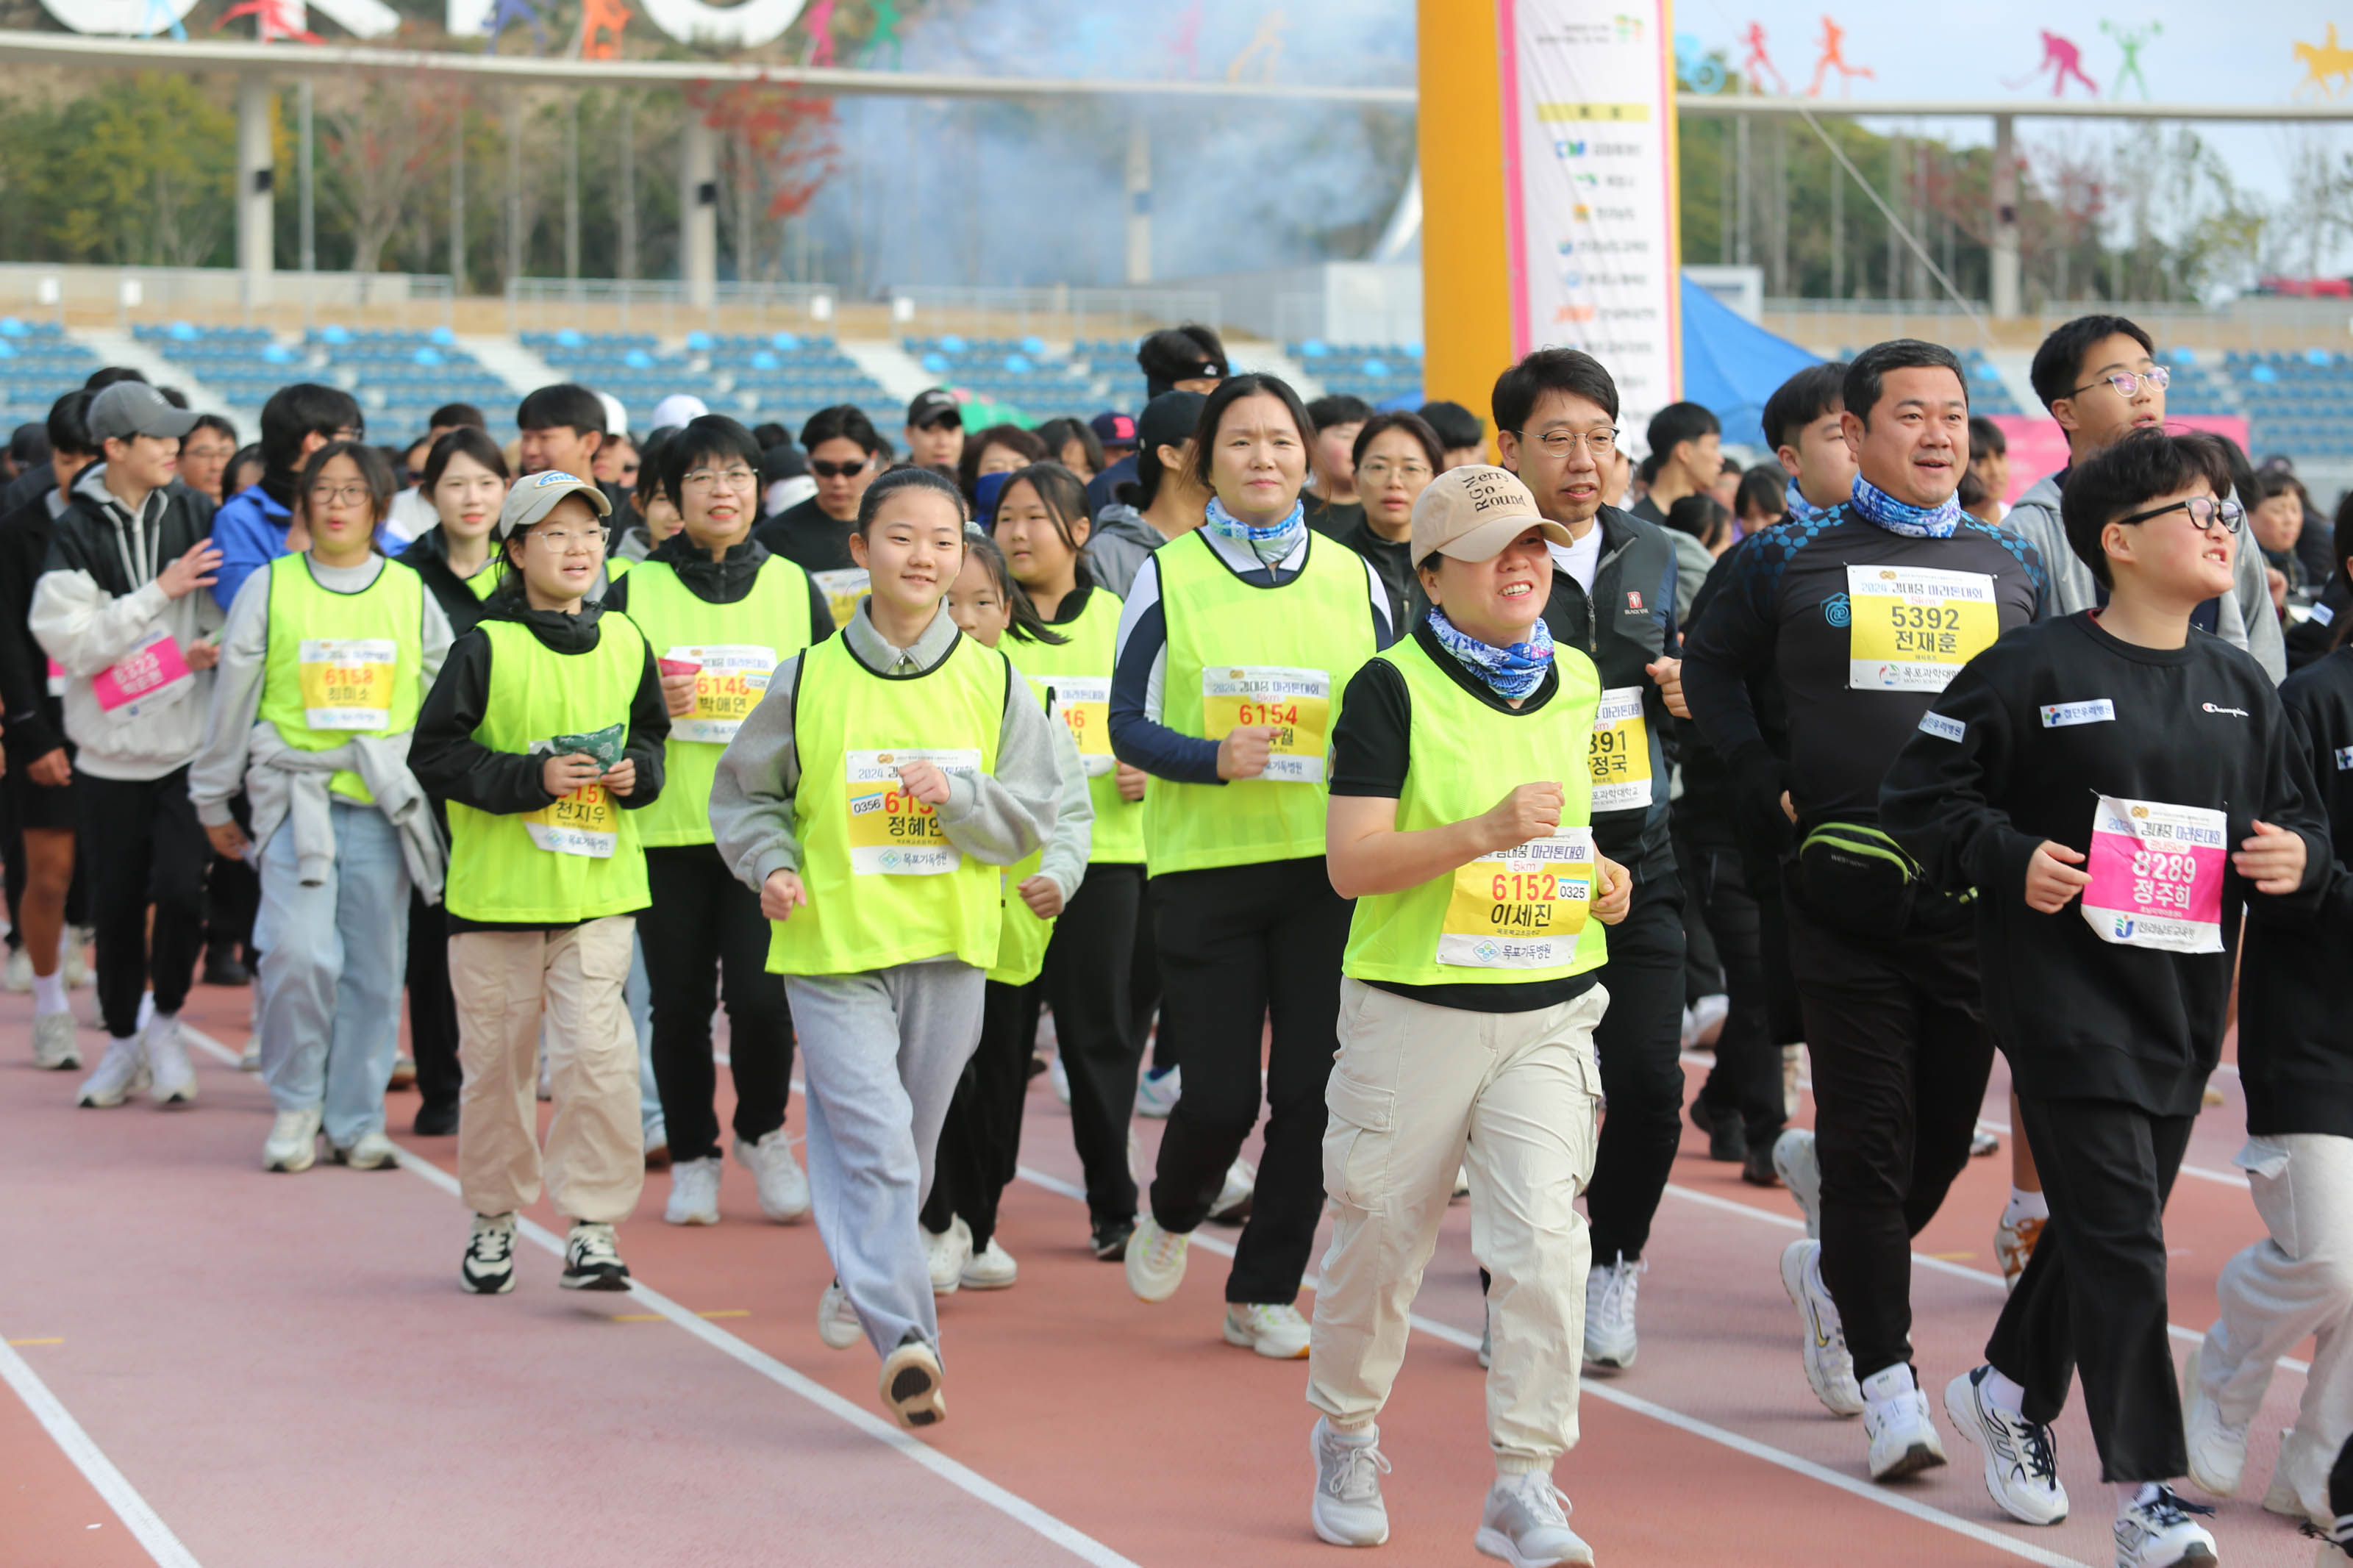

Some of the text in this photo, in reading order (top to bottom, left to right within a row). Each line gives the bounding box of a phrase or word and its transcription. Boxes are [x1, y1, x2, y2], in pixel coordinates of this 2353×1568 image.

[1462, 472, 1510, 490] Merry
[1474, 495, 1527, 512] Round
[1928, 584, 1983, 599] 마라톤대회
[1891, 606, 1960, 631] 5392
[1895, 630, 1957, 654] 전재훈
[324, 667, 374, 685] 6158
[1273, 681, 1320, 695] 마라톤대회
[699, 697, 747, 714] 박애연
[1602, 703, 1640, 718] 마라톤대회
[1239, 704, 1298, 726] 6154
[1594, 722, 1609, 730] km
[1589, 730, 1627, 754] 391
[858, 767, 883, 780] 2024
[1588, 754, 1627, 776] 정국
[557, 783, 607, 804] 157
[557, 801, 606, 824] 천지우
[854, 799, 881, 814] 0356
[903, 851, 948, 868] 목포기독병원
[1531, 844, 1586, 860] 마라톤대회
[1513, 859, 1536, 872] 5km
[2132, 850, 2196, 884] 8289
[1492, 873, 1556, 901] 6152
[1560, 885, 1585, 898] 0325
[2132, 878, 2191, 911] 정주희
[1490, 903, 1552, 927] 이세진
[1502, 942, 1552, 960] 목포기독병원
